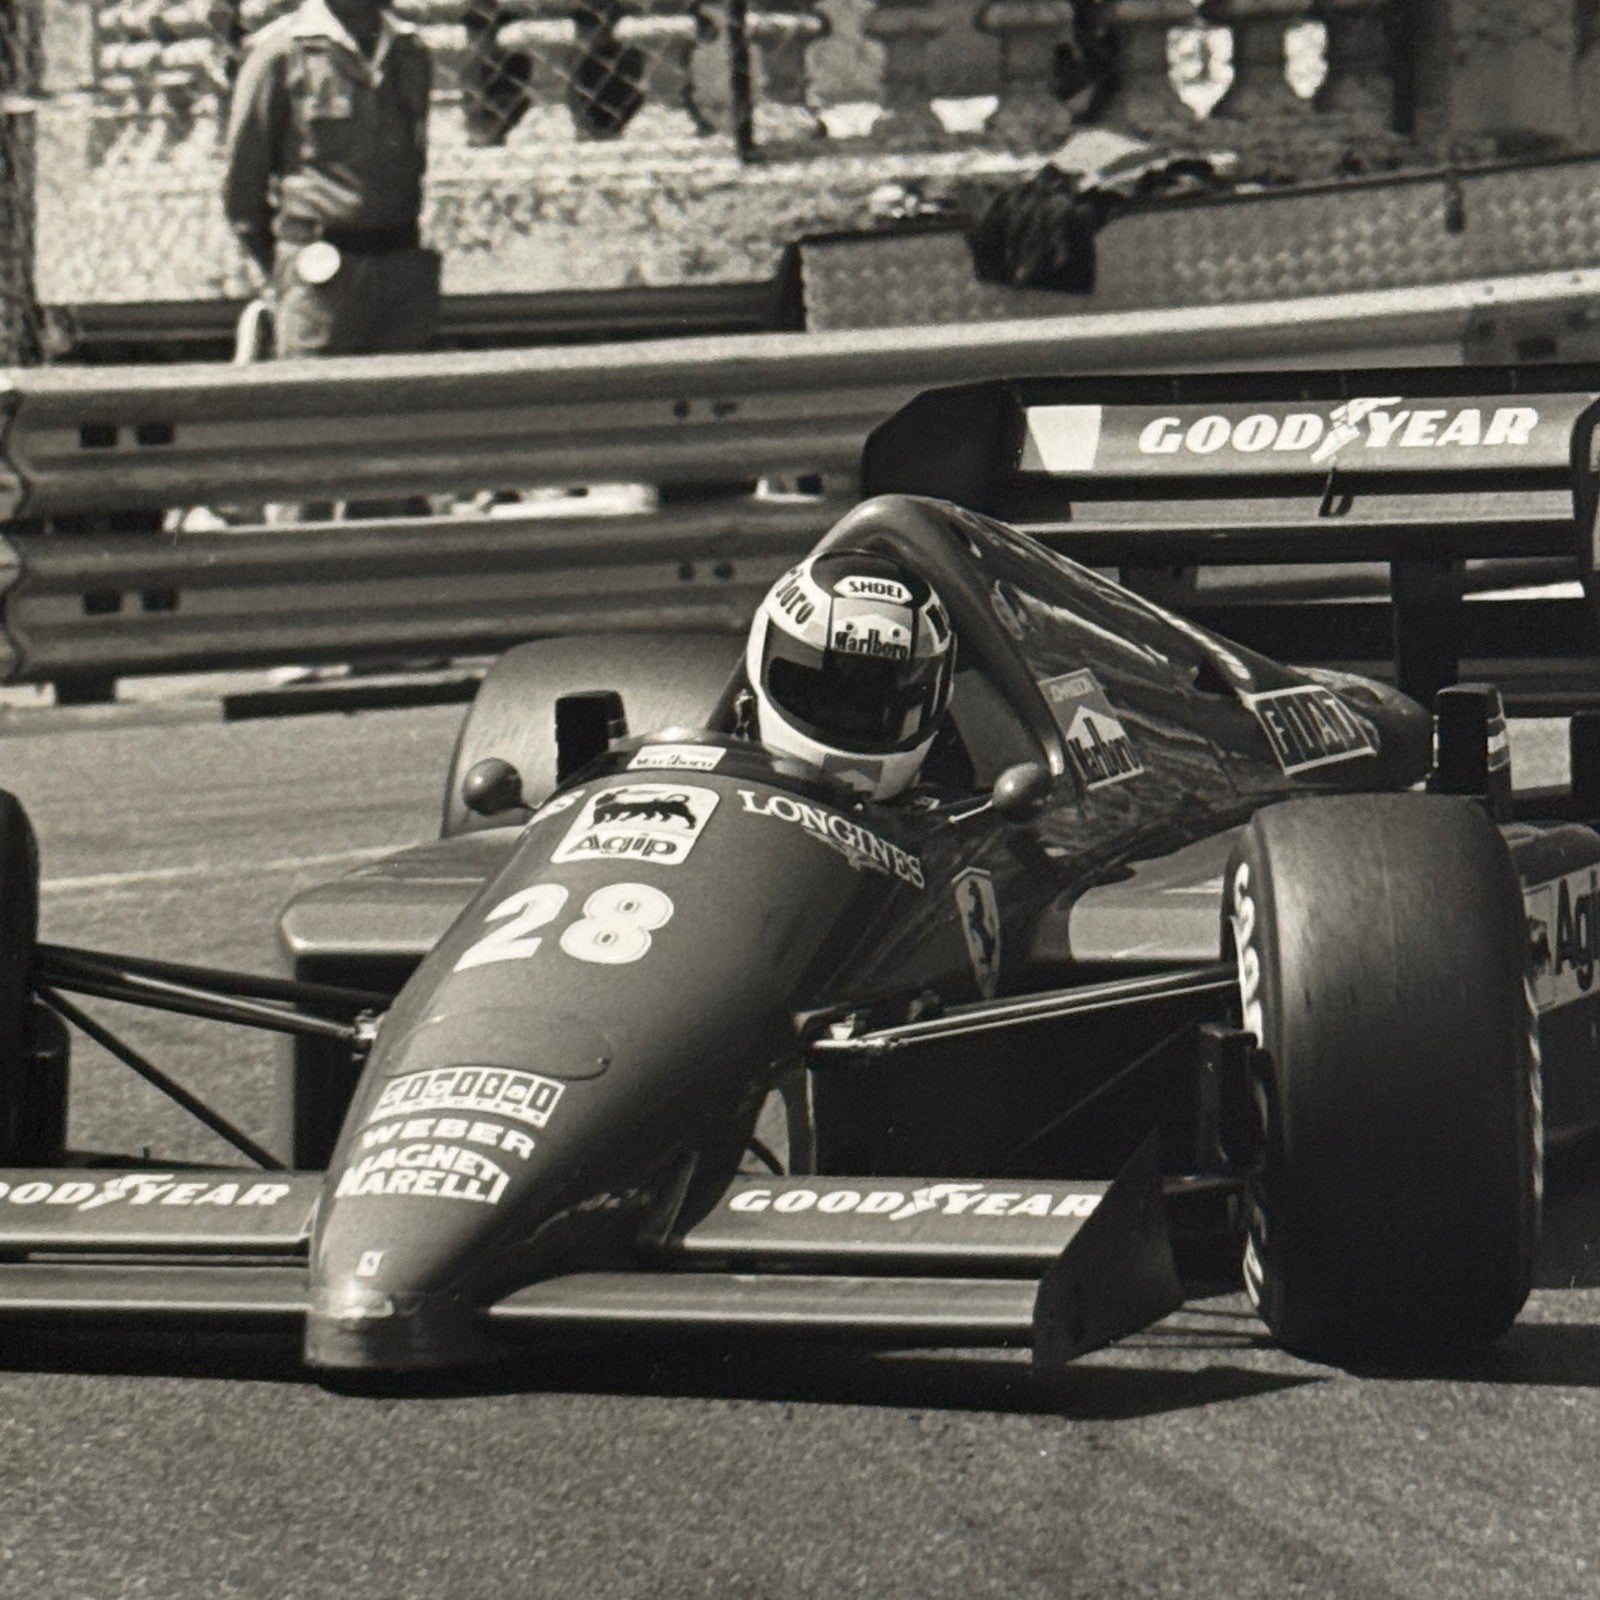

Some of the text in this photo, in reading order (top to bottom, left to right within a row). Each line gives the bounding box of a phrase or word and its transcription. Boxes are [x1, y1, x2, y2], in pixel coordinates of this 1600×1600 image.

[1138, 406, 1539, 453] GOODYEAR
[849, 580, 903, 598] SHOEI
[1264, 699, 1356, 755] FIAT
[566, 833, 677, 857] Agip
[737, 789, 925, 889] LONGINES
[453, 883, 674, 973] 28
[361, 1117, 536, 1161] WEBER
[0, 1182, 290, 1206] ODYEAR
